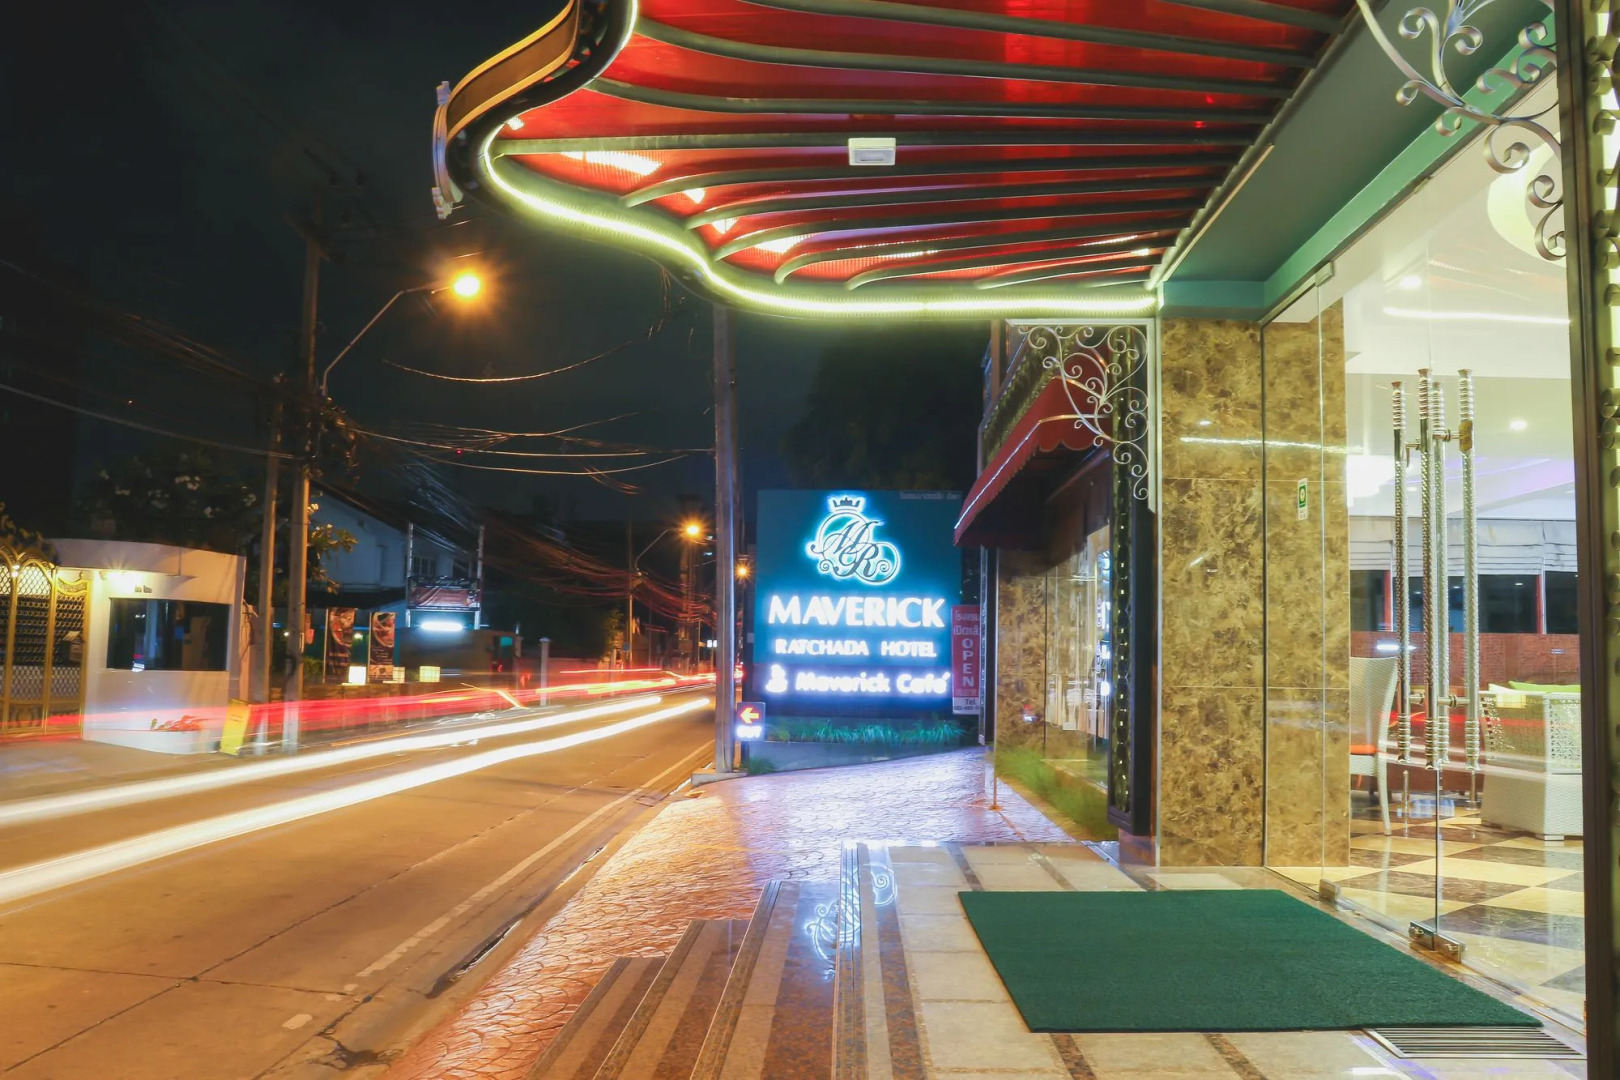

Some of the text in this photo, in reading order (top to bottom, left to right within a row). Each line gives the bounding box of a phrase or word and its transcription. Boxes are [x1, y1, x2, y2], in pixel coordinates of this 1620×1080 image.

[768, 595, 946, 628] MAVERICK
[775, 639, 937, 657] RATCHADA HOTEL
[961, 638, 975, 687] OPEN
[795, 672, 891, 693] Maverick
